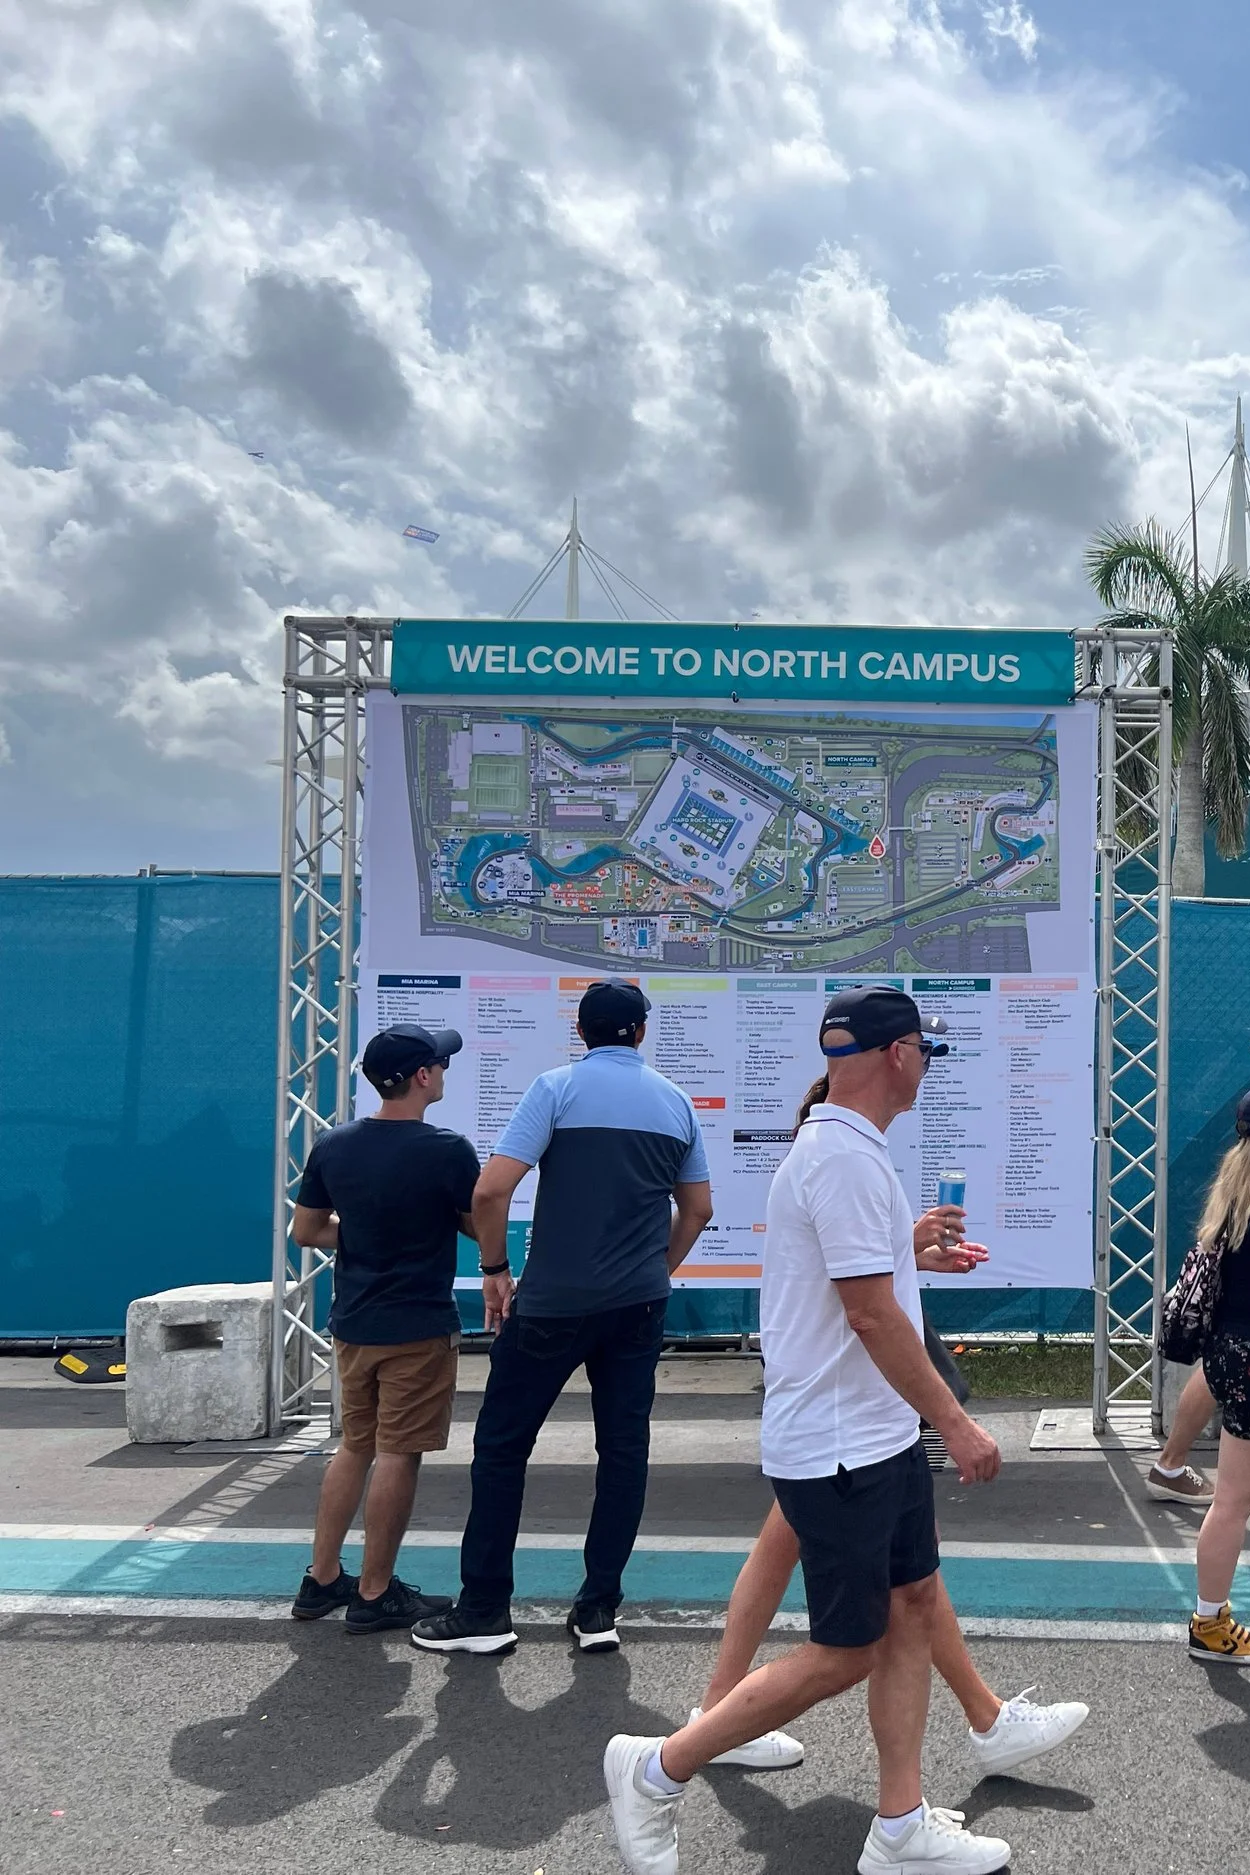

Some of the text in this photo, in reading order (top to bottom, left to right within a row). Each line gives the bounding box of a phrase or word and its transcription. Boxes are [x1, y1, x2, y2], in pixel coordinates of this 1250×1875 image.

[448, 645, 1020, 682] WELCOME TO NORTH CAMPUS
